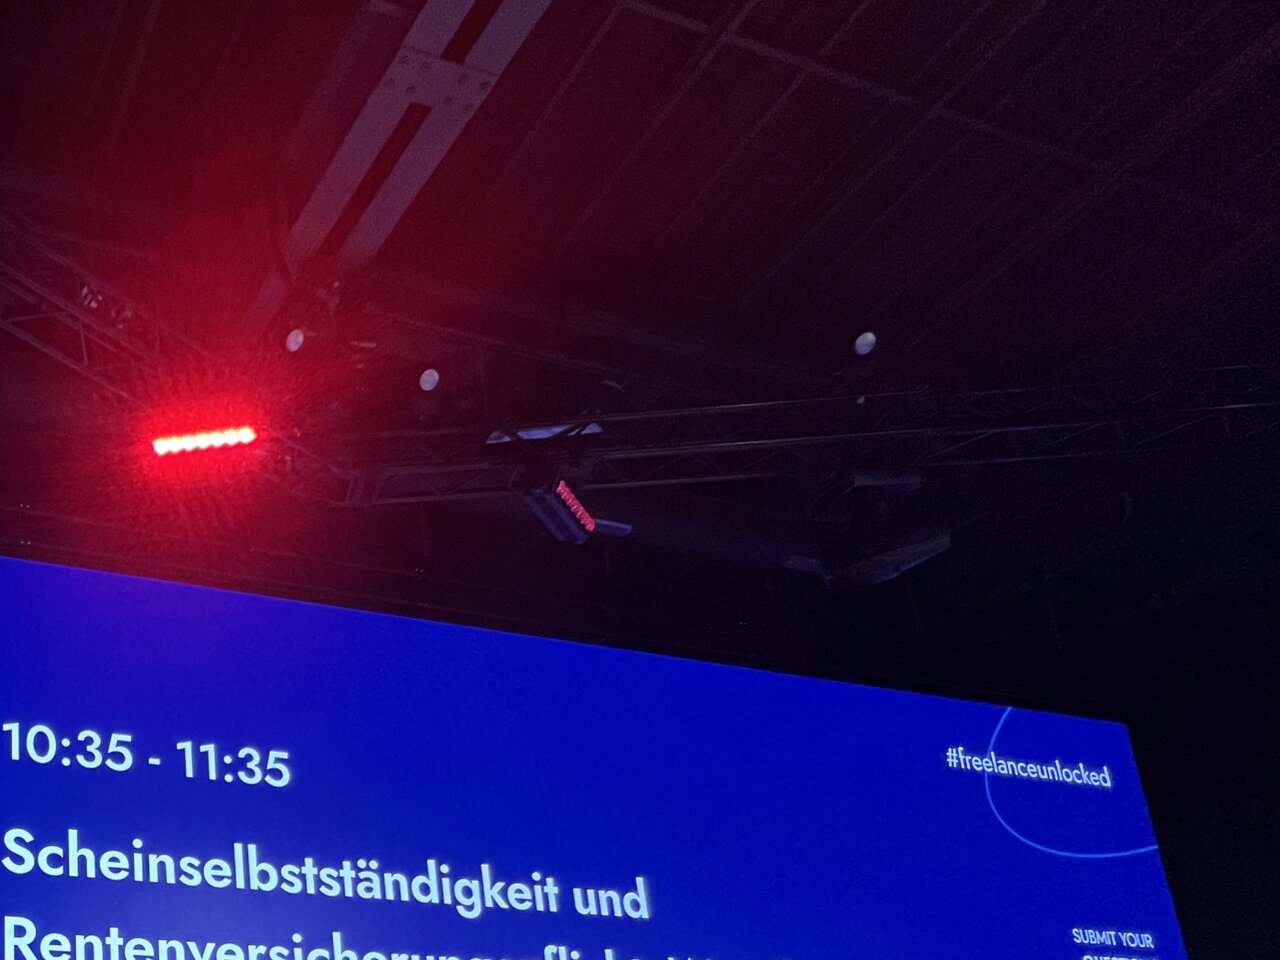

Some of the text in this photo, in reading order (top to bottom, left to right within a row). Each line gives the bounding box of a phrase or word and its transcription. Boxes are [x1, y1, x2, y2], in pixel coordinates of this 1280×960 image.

[2, 721, 134, 772] 10:35
[176, 740, 291, 788] 11:35
[945, 746, 1112, 788] #freelanceunlocked
[1, 827, 651, 920] Scheinselbstständigkeit und
[1071, 927, 1155, 949] SUBMIT YOUR
